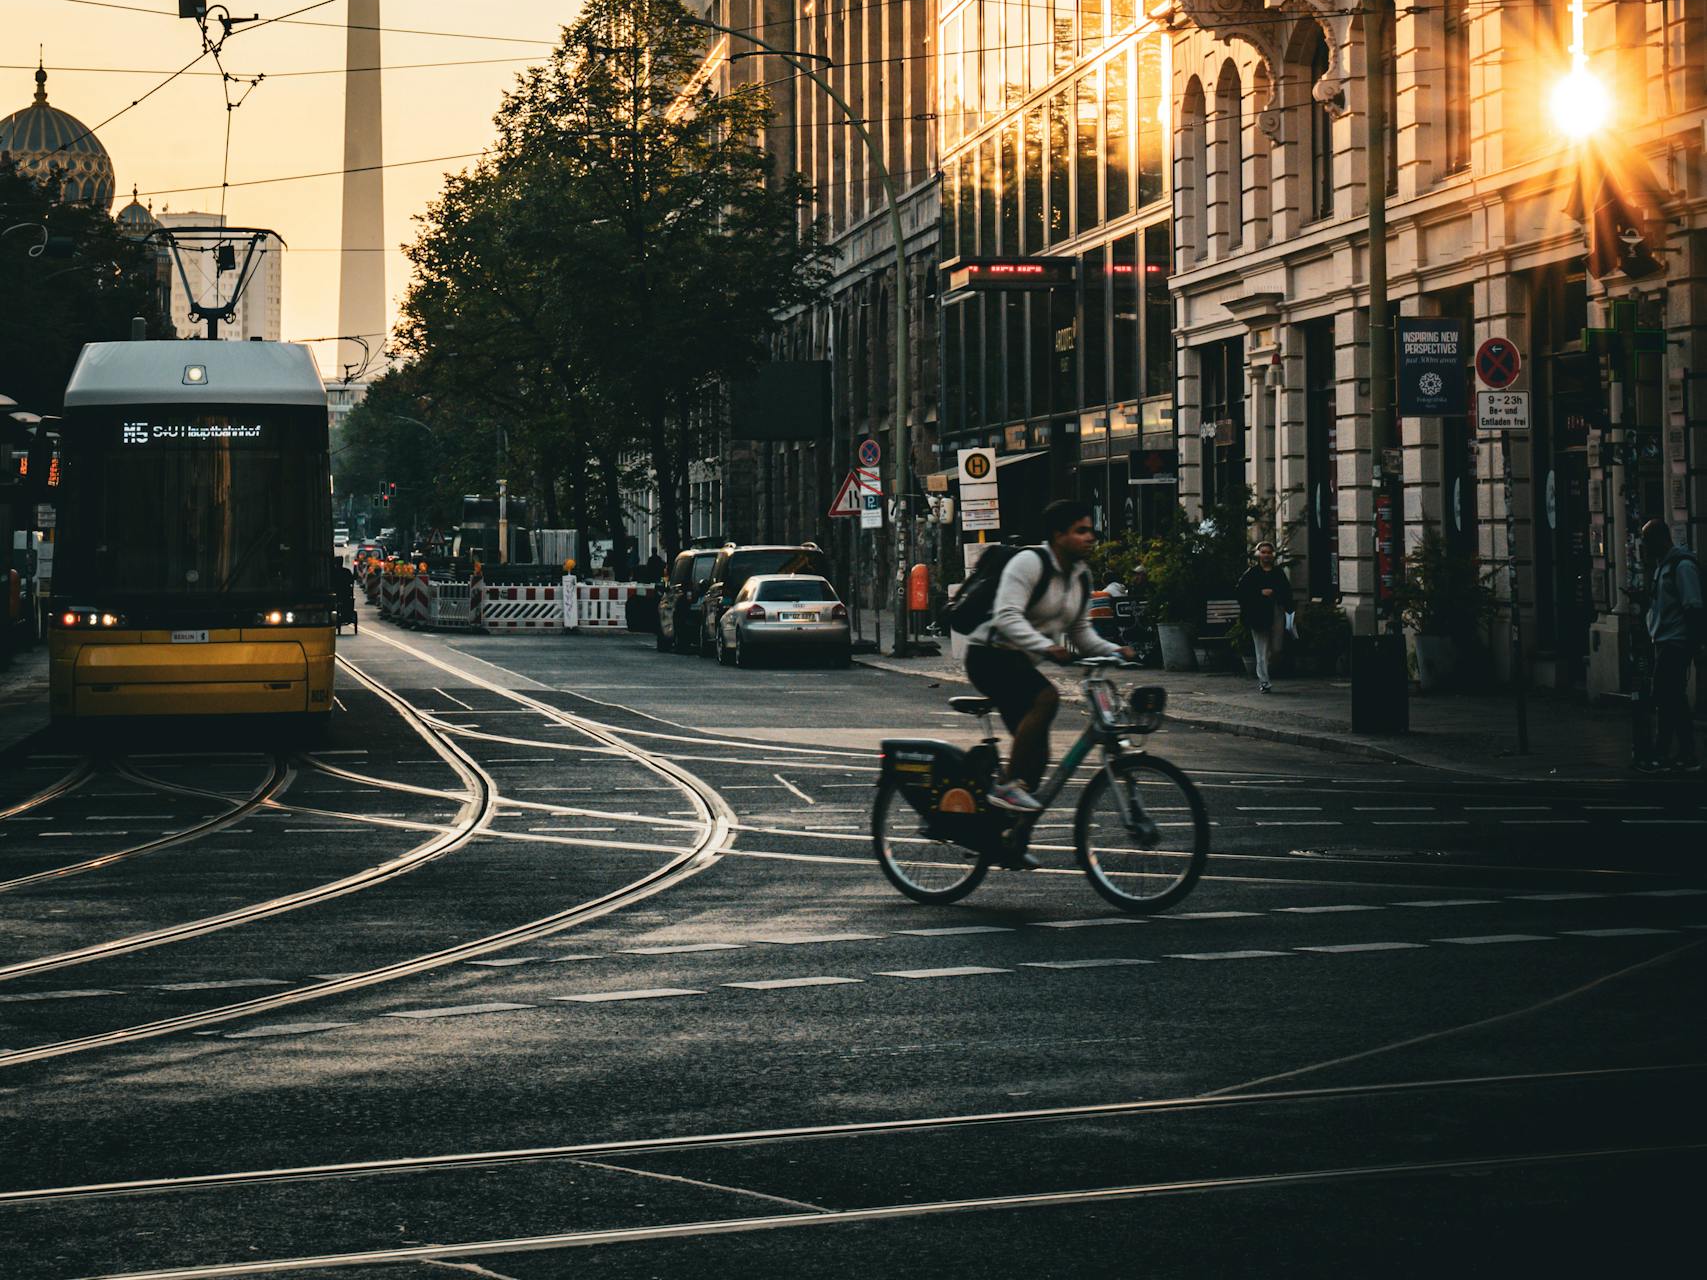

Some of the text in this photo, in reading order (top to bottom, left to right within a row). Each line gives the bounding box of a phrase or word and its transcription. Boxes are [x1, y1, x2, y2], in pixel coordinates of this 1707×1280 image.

[1403, 331, 1458, 343] INSPIRING NEW
[1405, 343, 1457, 354] PERSPECTIVES
[1488, 395, 1495, 404] 9
[1504, 395, 1522, 405] 23h
[1489, 406, 1518, 415] Be- und
[1481, 417, 1526, 426] Entladen frei
[124, 423, 149, 443] M5
